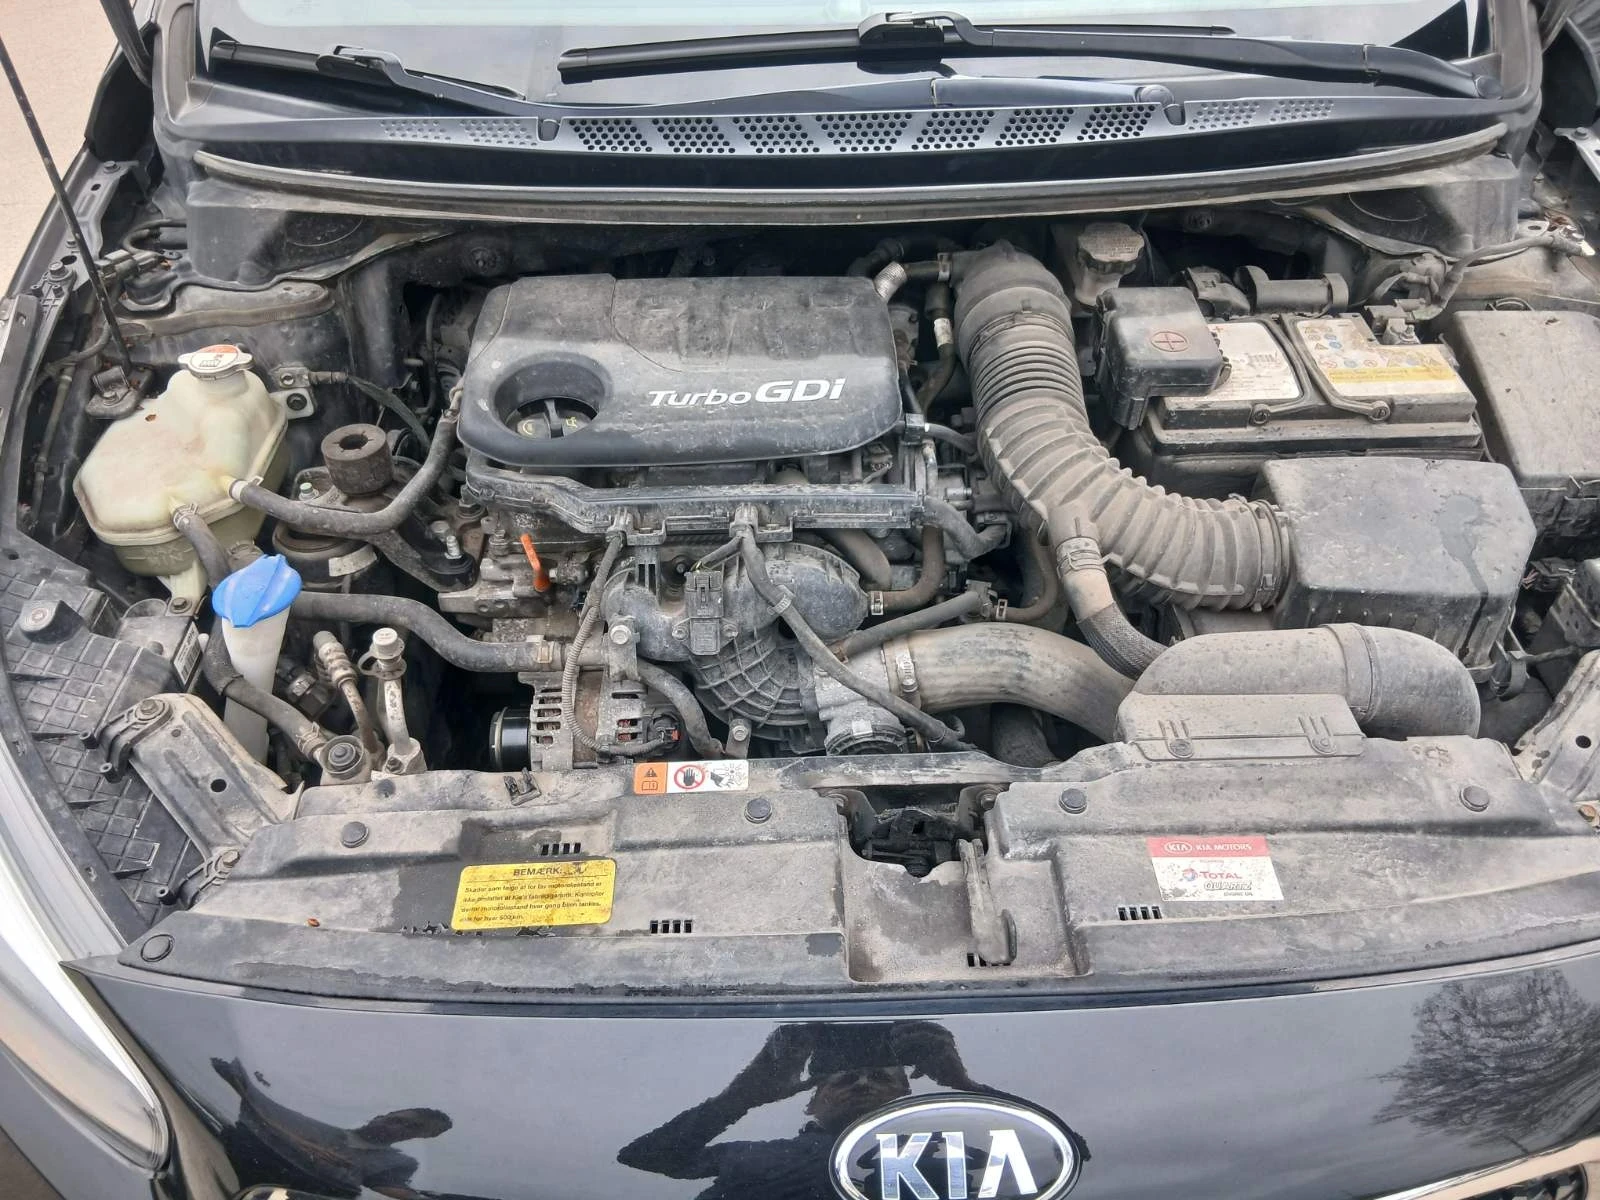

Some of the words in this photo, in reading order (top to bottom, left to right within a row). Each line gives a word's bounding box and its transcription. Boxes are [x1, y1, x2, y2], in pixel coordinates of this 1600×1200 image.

[1213, 843, 1253, 851] MOTORS
[1199, 871, 1243, 880] TOTAL
[876, 1129, 1038, 1200] KIA
